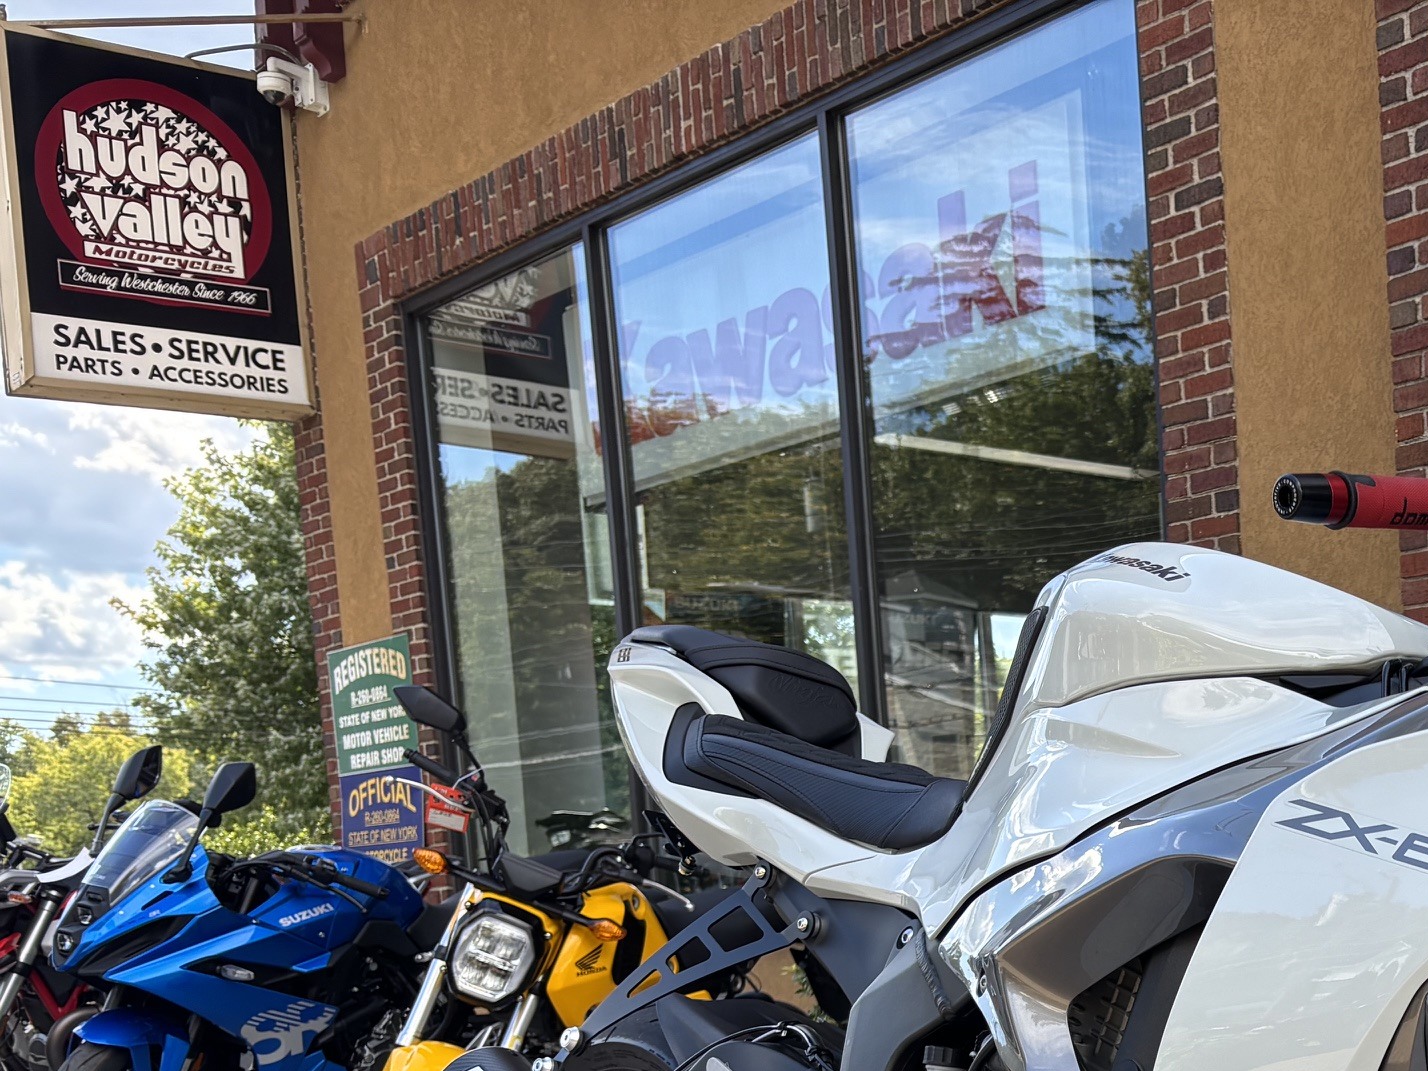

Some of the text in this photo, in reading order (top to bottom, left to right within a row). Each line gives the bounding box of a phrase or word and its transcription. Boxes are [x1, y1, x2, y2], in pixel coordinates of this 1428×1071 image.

[62, 109, 250, 199] hudson
[92, 244, 236, 275] Motorcycles
[73, 266, 257, 305] Serving Westchester Since 1966
[53, 323, 286, 372] SALES SERVICE
[55, 354, 289, 394] PARTS ACCESSORIES
[333, 646, 407, 695] REGISTERED
[339, 714, 360, 728] STATE
[361, 711, 370, 724] OF
[371, 708, 387, 723] NEW
[343, 724, 410, 750] MOTOR VEHICLE
[350, 746, 405, 769] REPAIR SHOP
[349, 776, 416, 817] OFFICIAL
[348, 825, 418, 847] STATE OF NEW YORK
[361, 846, 408, 865] TORCYCLE
[279, 902, 334, 928] SUZUKI
